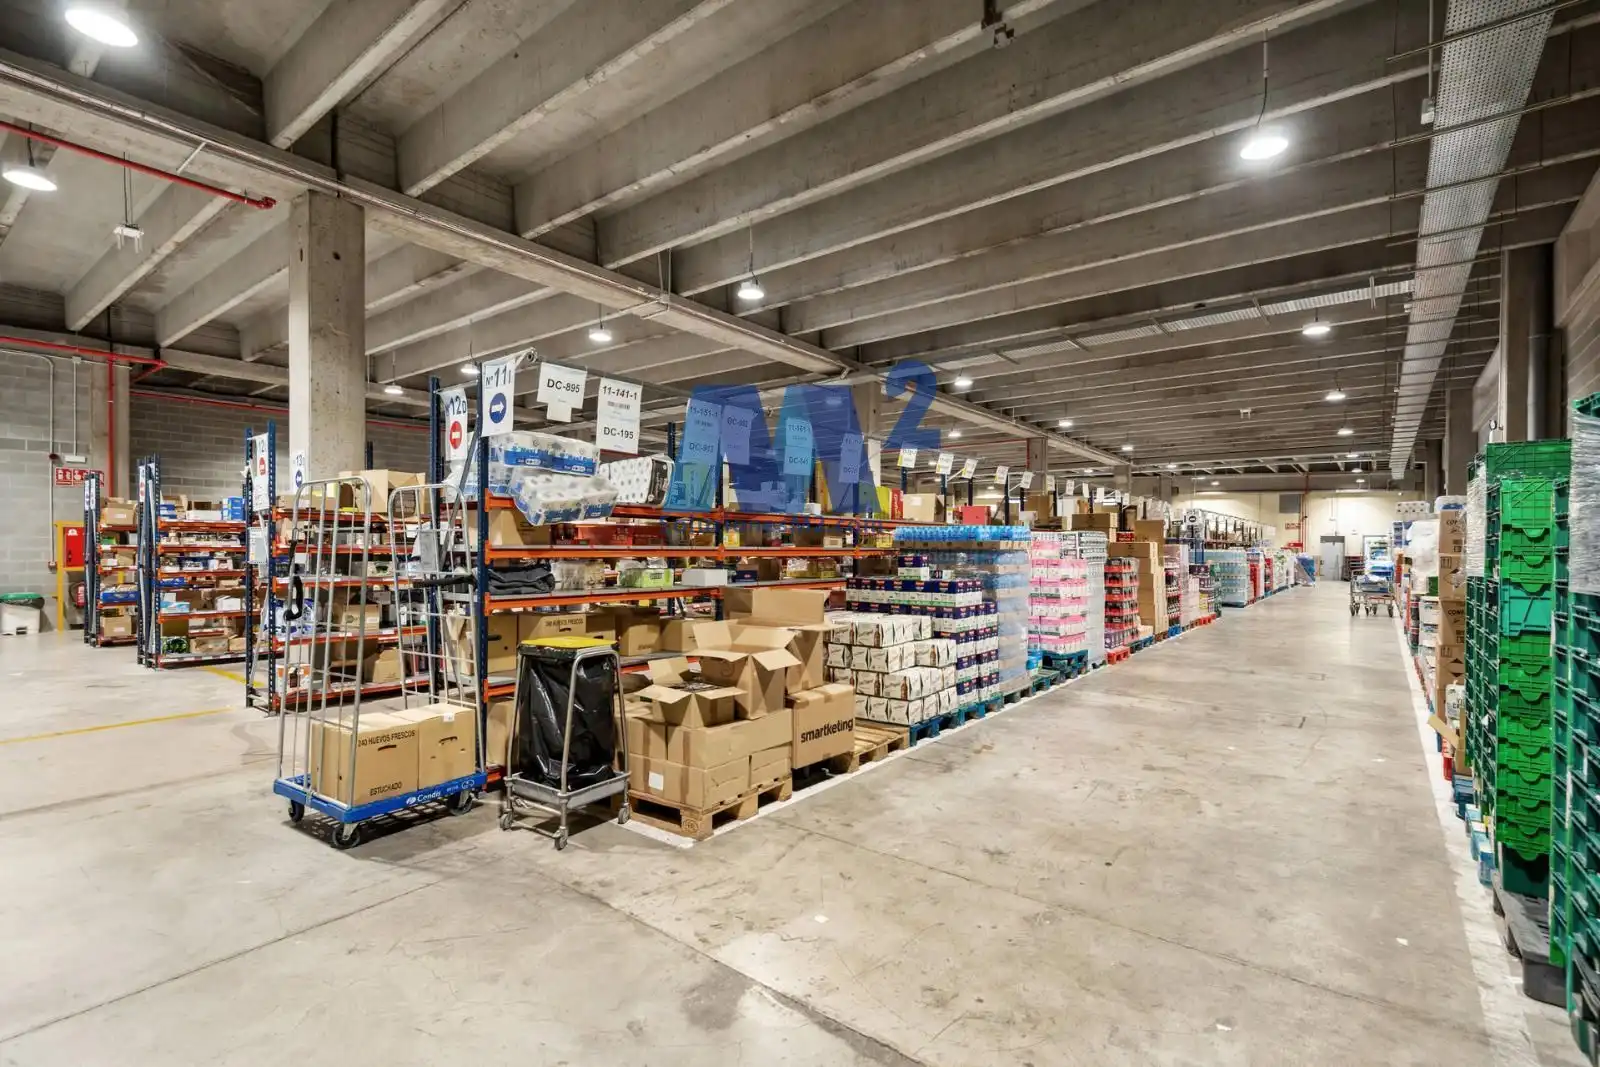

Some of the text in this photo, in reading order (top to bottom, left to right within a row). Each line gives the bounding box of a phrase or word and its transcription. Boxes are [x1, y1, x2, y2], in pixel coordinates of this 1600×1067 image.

[547, 379, 580, 393] DC-895
[602, 386, 637, 400] 11-141-1
[603, 426, 634, 439] DC-195
[368, 734, 391, 745] HUEVOS
[390, 730, 416, 741] FRESCOS
[801, 718, 853, 743] smartketing
[369, 781, 403, 797] ESTUCHADO
